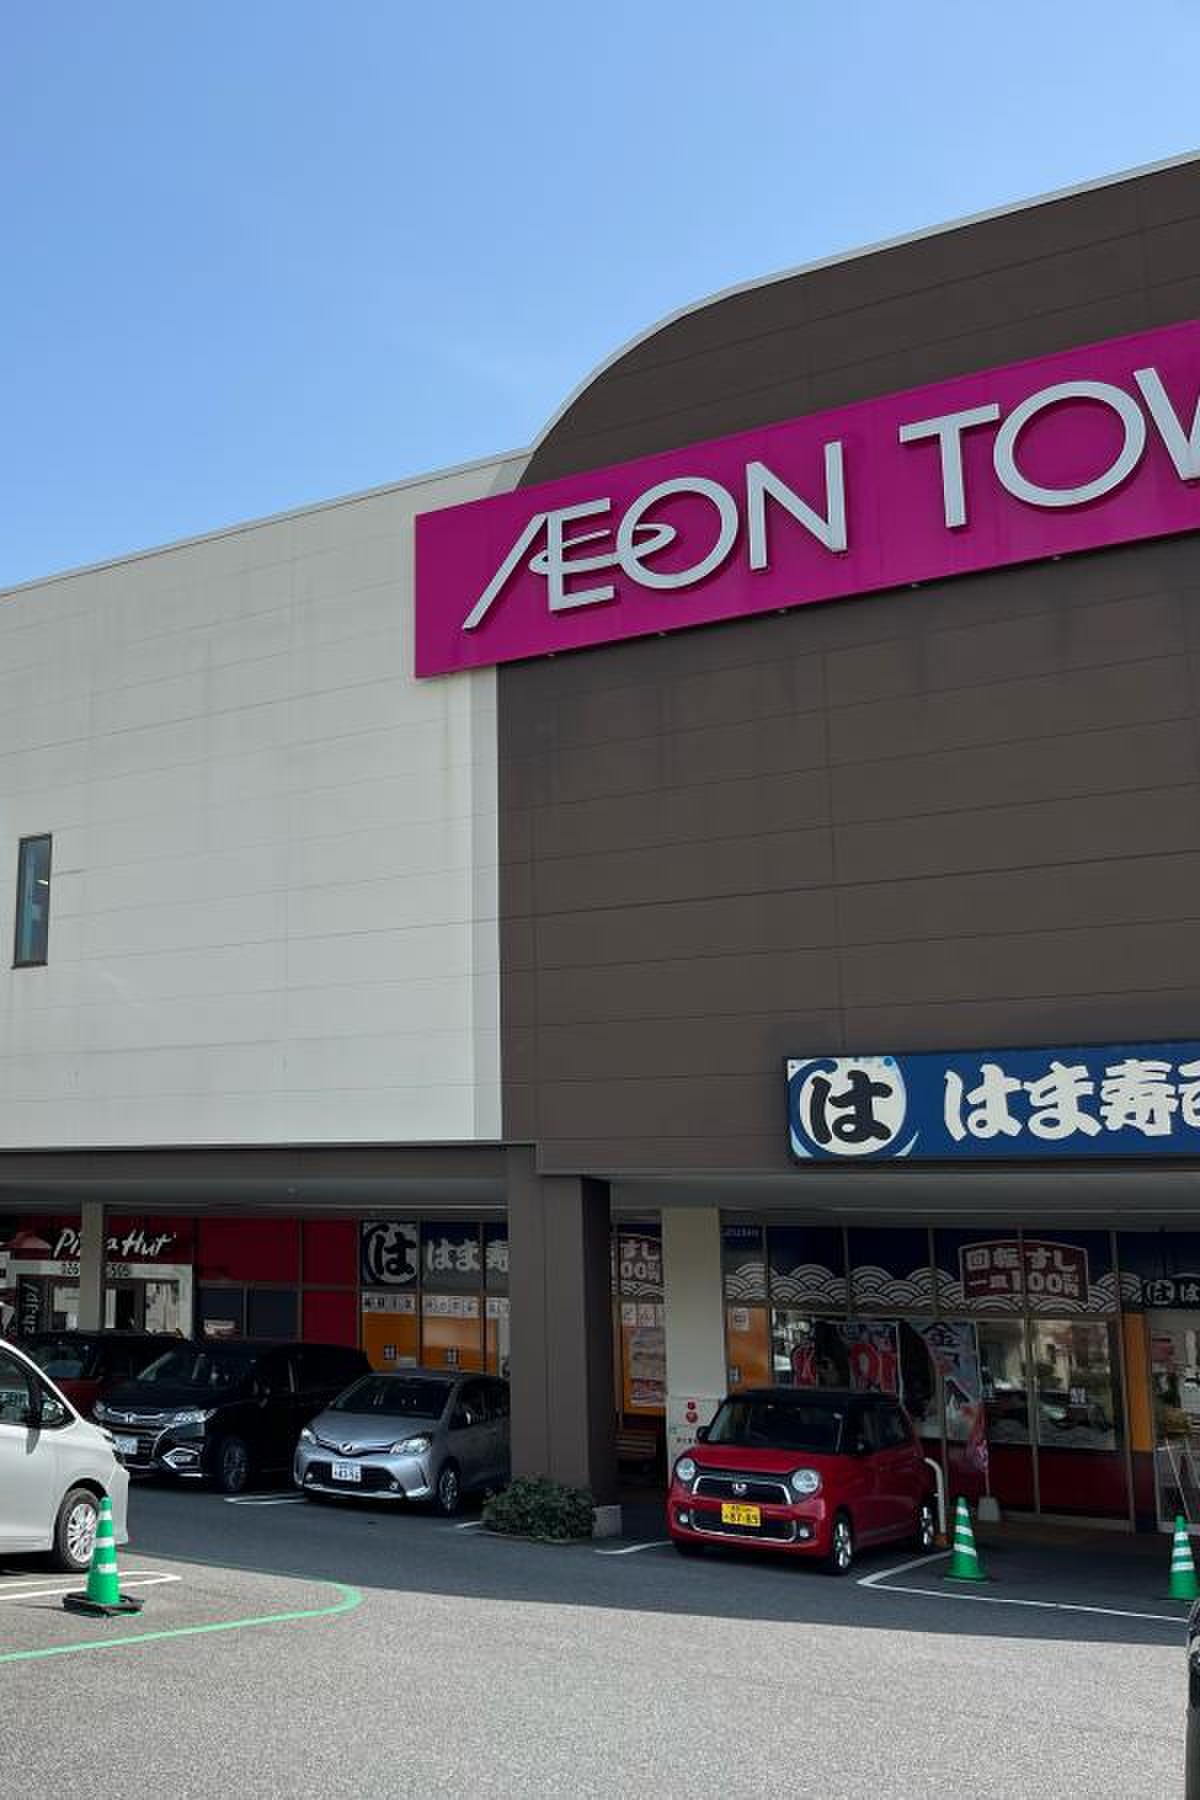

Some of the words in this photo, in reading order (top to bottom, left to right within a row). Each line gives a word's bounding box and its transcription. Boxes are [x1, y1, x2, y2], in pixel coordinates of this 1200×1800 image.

[810, 1070, 893, 1144] は
[54, 1227, 119, 1258] Pia
[121, 1229, 172, 1257] Hut
